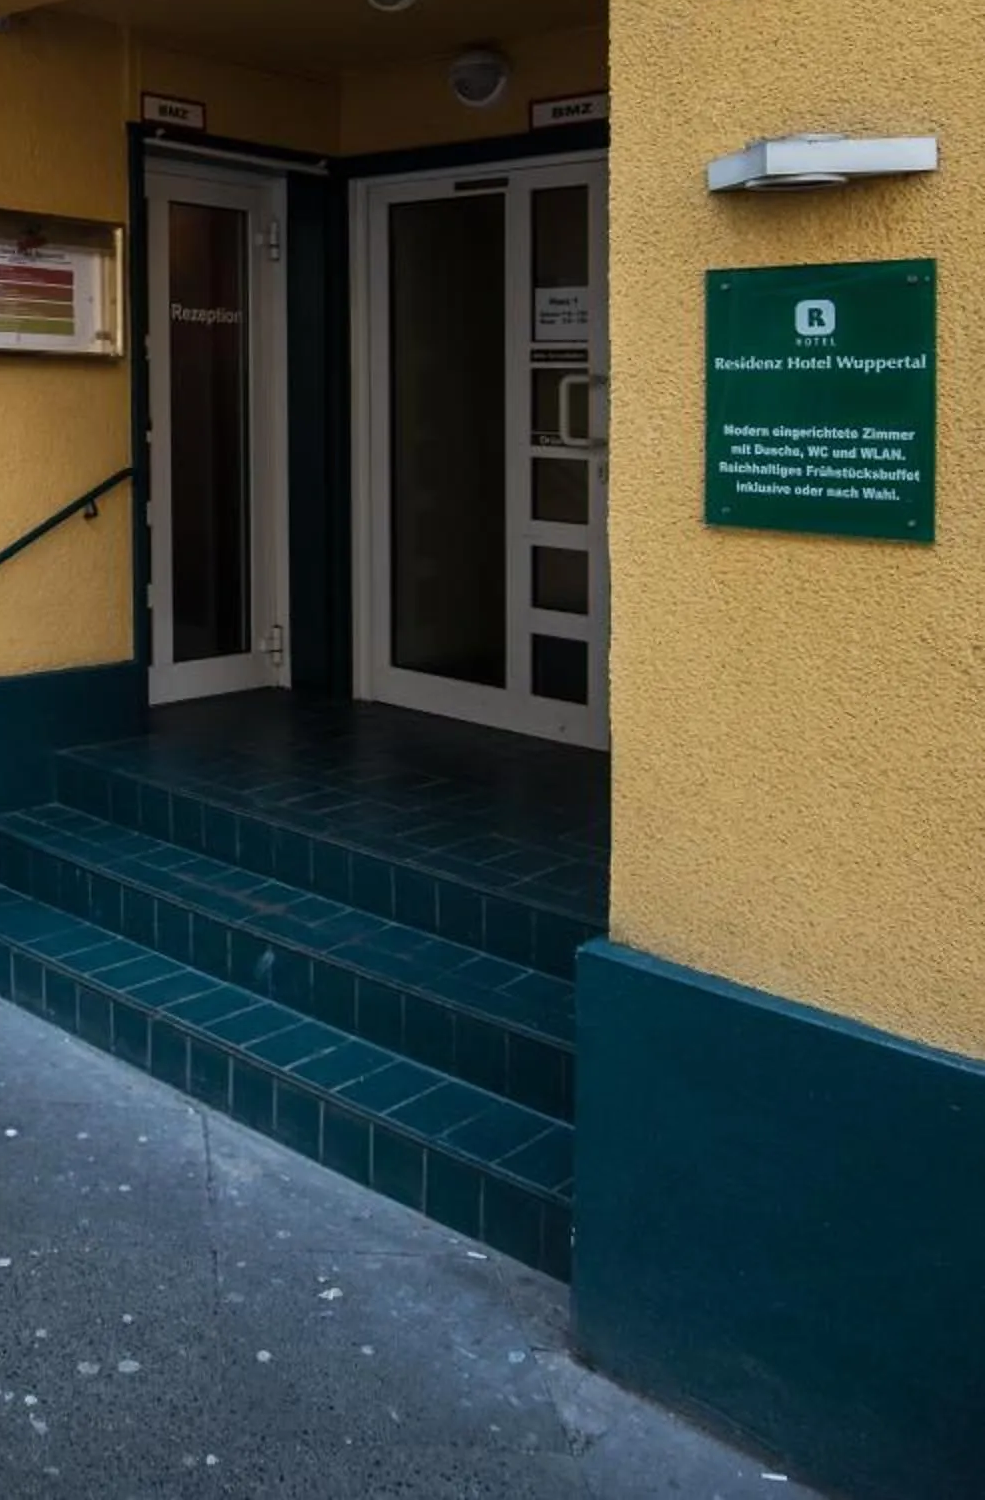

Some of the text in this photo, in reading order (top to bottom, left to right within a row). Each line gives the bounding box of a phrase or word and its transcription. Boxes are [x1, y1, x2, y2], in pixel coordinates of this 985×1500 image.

[552, 102, 594, 119] BMZ
[170, 303, 243, 326] Rezeption
[794, 337, 837, 347] HOTEL
[714, 354, 927, 373] Residenz Hotel Wuppertal
[723, 424, 916, 441] Modern eingerichtete Zimmer
[731, 444, 907, 461] mit Dusche, WC und WLAN.
[718, 461, 803, 479] Reichhaltiges
[794, 484, 823, 498] oder
[826, 487, 859, 499] nach
[862, 487, 900, 501] Wahl.
